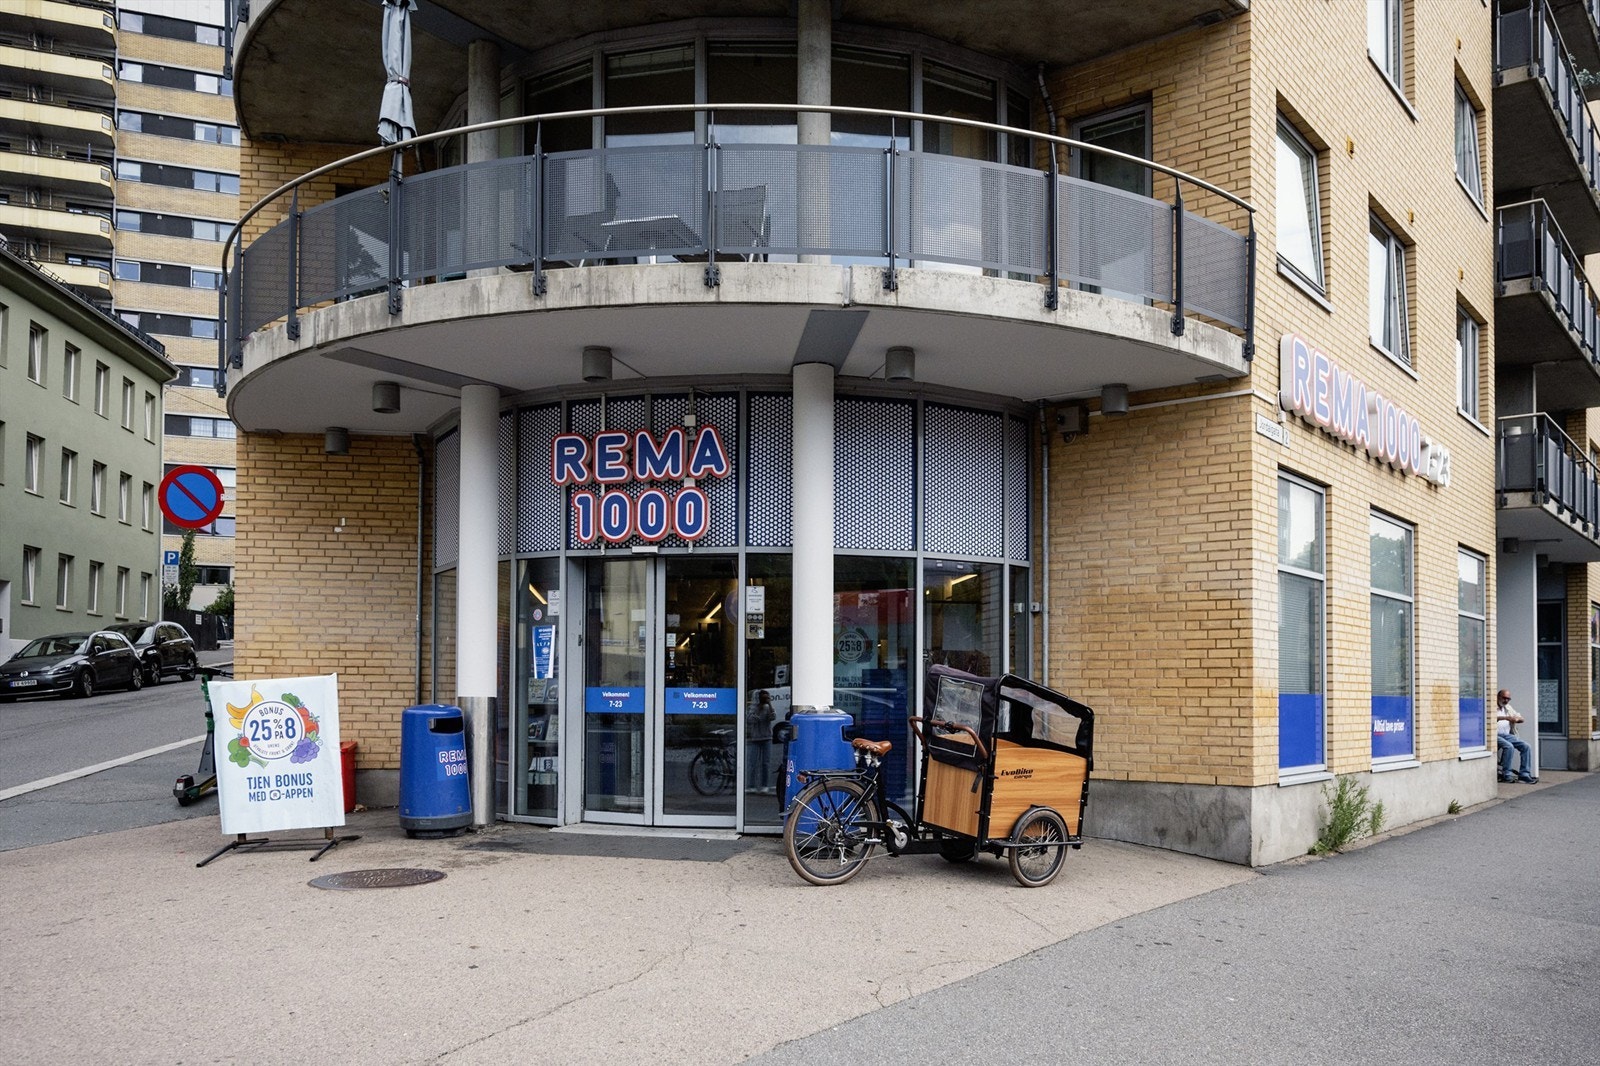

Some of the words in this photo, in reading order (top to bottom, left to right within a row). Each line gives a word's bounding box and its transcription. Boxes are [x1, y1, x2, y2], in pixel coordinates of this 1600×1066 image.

[1292, 332, 1371, 450] REMA
[1375, 392, 1421, 475] 1000
[551, 425, 732, 486] REMA
[572, 487, 710, 543] 1000
[167, 552, 176, 564] P
[839, 640, 850, 652] 25
[856, 640, 862, 652] 8
[602, 690, 630, 698] Velkommen!
[609, 700, 623, 708] 7-23
[692, 701, 708, 709] 7-23
[259, 706, 284, 717] BONUS
[249, 719, 272, 741] 25
[273, 718, 283, 730] %
[285, 717, 296, 739] 8
[246, 776, 271, 790] TJEN
[275, 772, 313, 788] BONUS
[248, 791, 267, 802] MED
